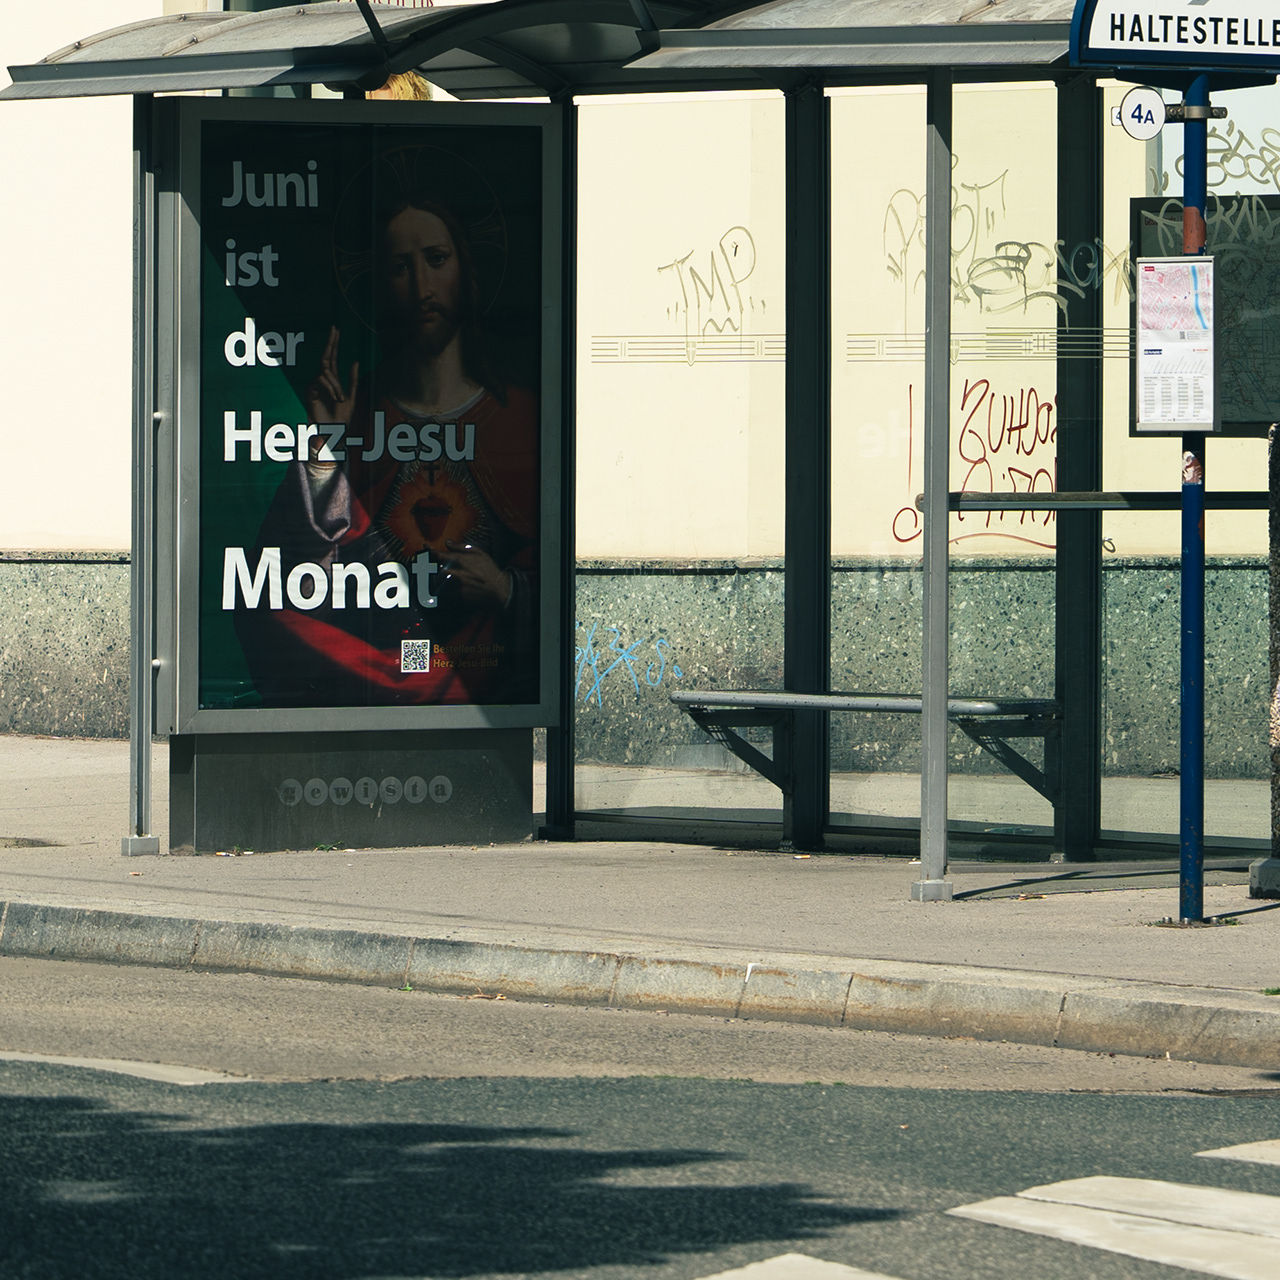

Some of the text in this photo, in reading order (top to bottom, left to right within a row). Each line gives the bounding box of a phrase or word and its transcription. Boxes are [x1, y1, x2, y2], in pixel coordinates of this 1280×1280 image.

[1131, 103, 1155, 125] 4A
[221, 159, 319, 208] Juni
[224, 239, 279, 288] ist
[223, 317, 305, 368] der
[222, 410, 476, 463] Herz-Jesu
[221, 545, 439, 612] Monat
[433, 643, 476, 654] Bestellen
[477, 644, 491, 654] Sie
[283, 780, 448, 803] gewista
